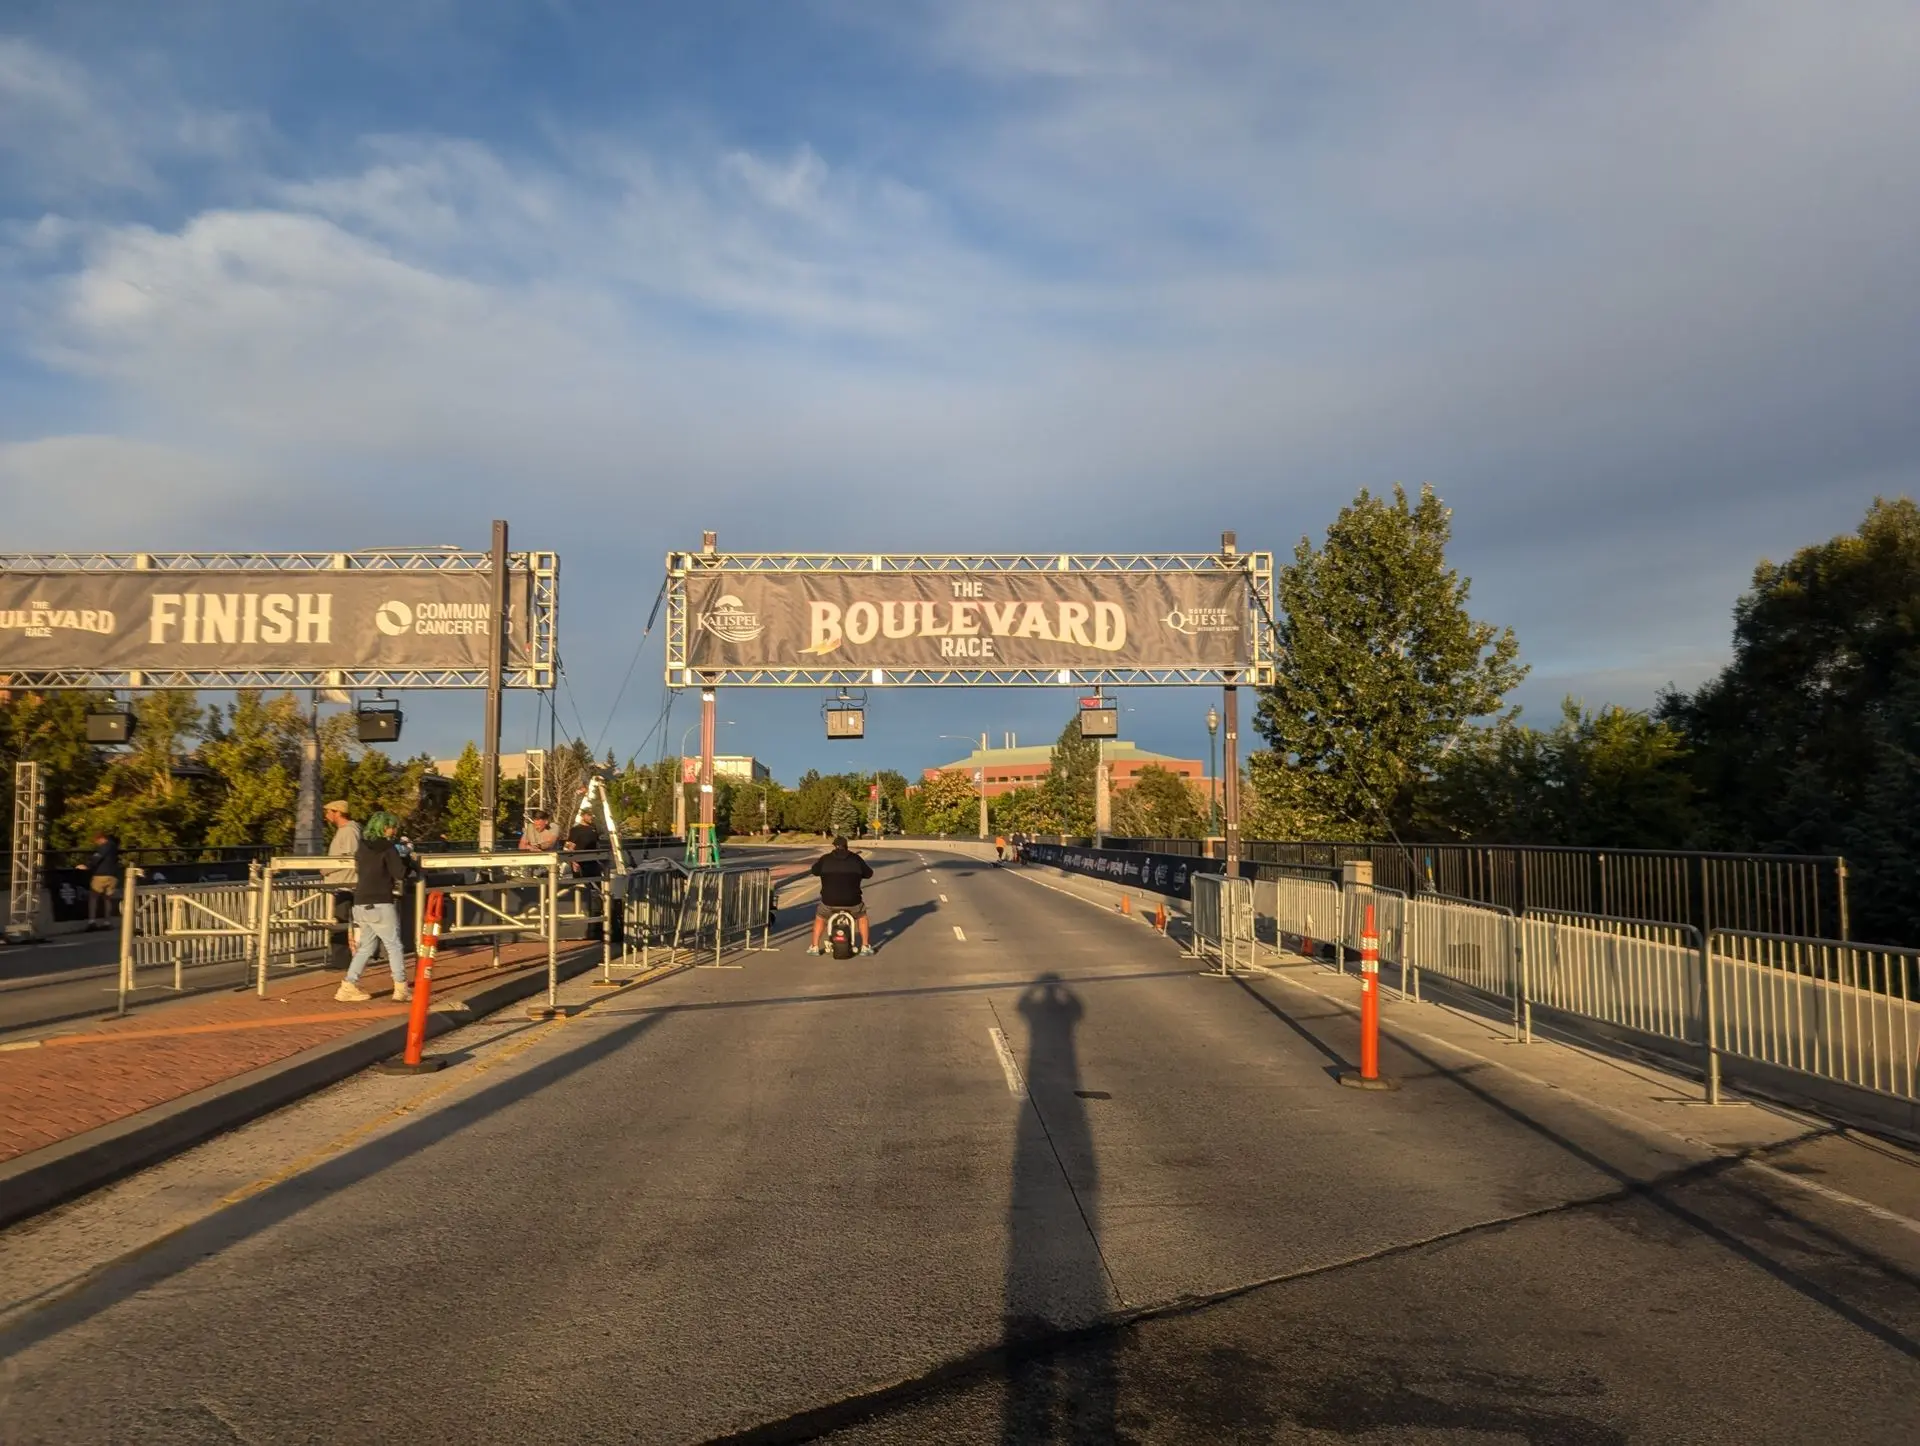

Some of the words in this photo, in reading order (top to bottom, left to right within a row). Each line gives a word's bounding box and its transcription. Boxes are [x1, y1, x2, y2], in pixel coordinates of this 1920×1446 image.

[952, 582, 983, 597] THE
[31, 601, 50, 609] THE
[415, 603, 516, 619] COMMUNY
[148, 593, 333, 644] FINISH
[696, 612, 760, 630] KALISPEL
[804, 601, 1126, 652] BOULEVARD
[1162, 607, 1228, 634] QUEST
[25, 627, 53, 637] RACE
[415, 620, 472, 635] CANCER
[941, 637, 995, 657] RACE
